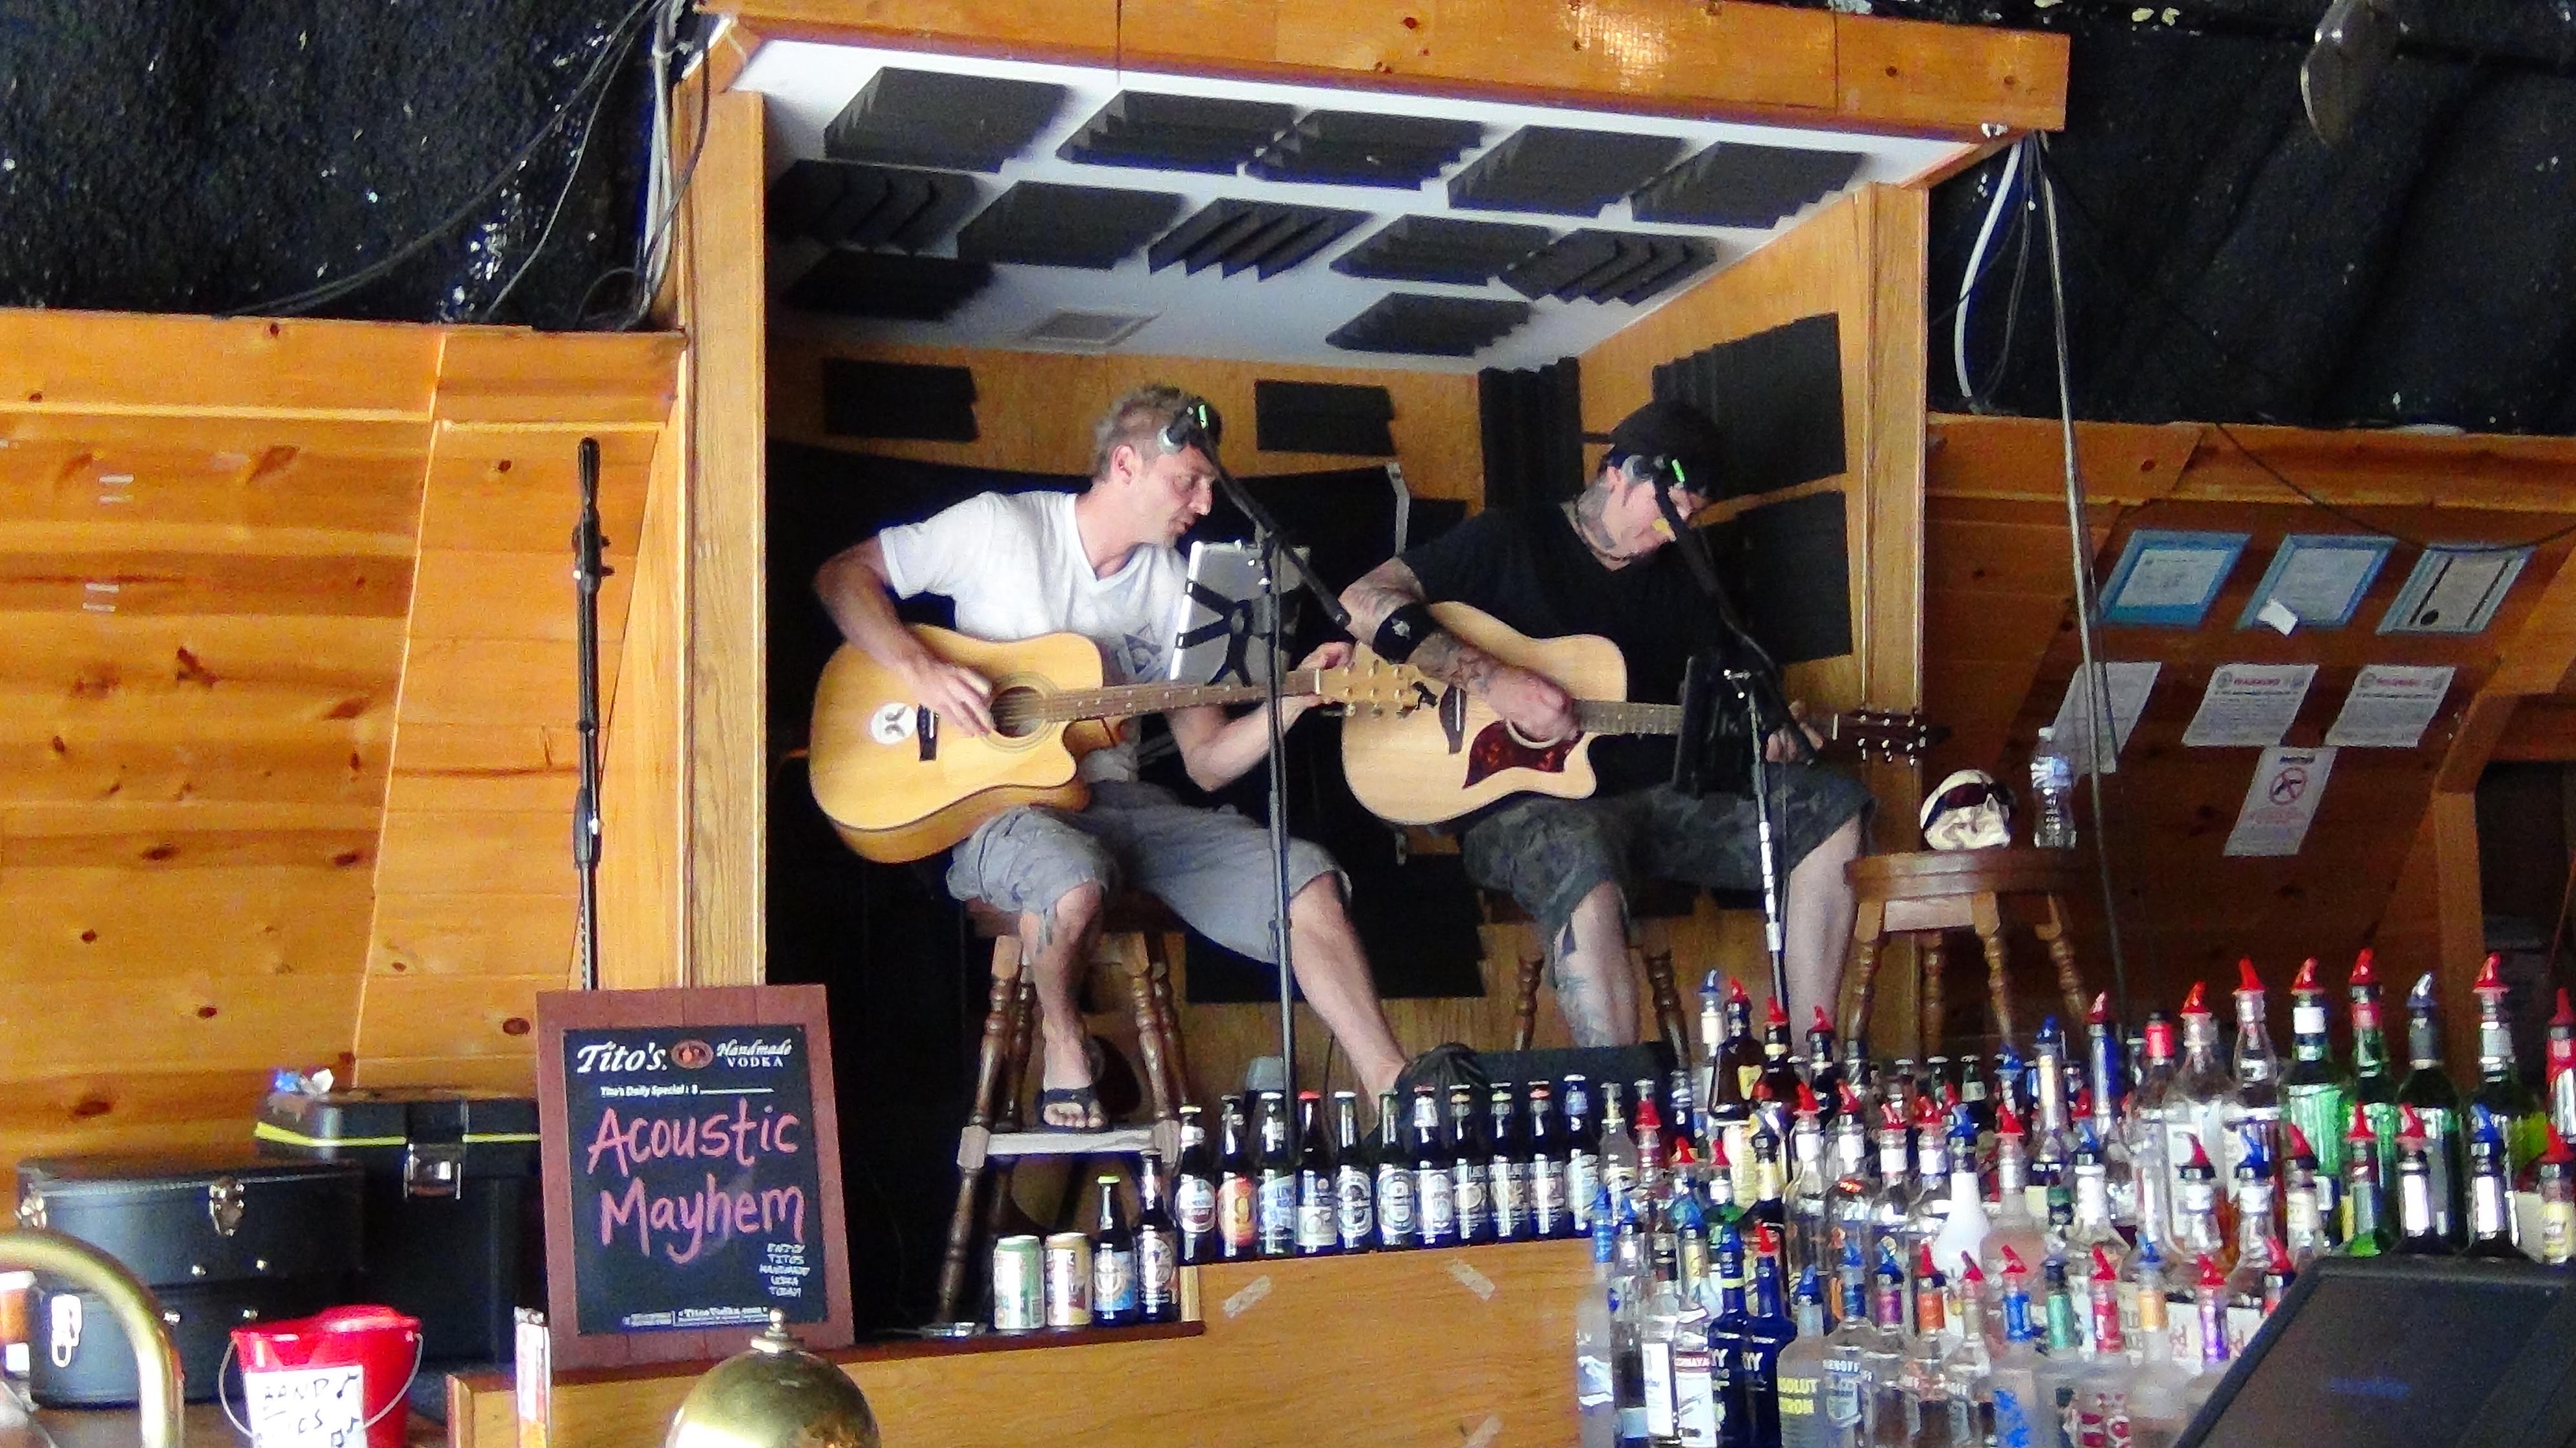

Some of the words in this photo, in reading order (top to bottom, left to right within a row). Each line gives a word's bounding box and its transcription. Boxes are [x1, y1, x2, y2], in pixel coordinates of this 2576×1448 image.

[716, 1038, 792, 1056] Handmade
[727, 1056, 784, 1067] VODKA
[587, 1097, 800, 1176] Acoustic
[600, 1173, 806, 1264] Mayhem
